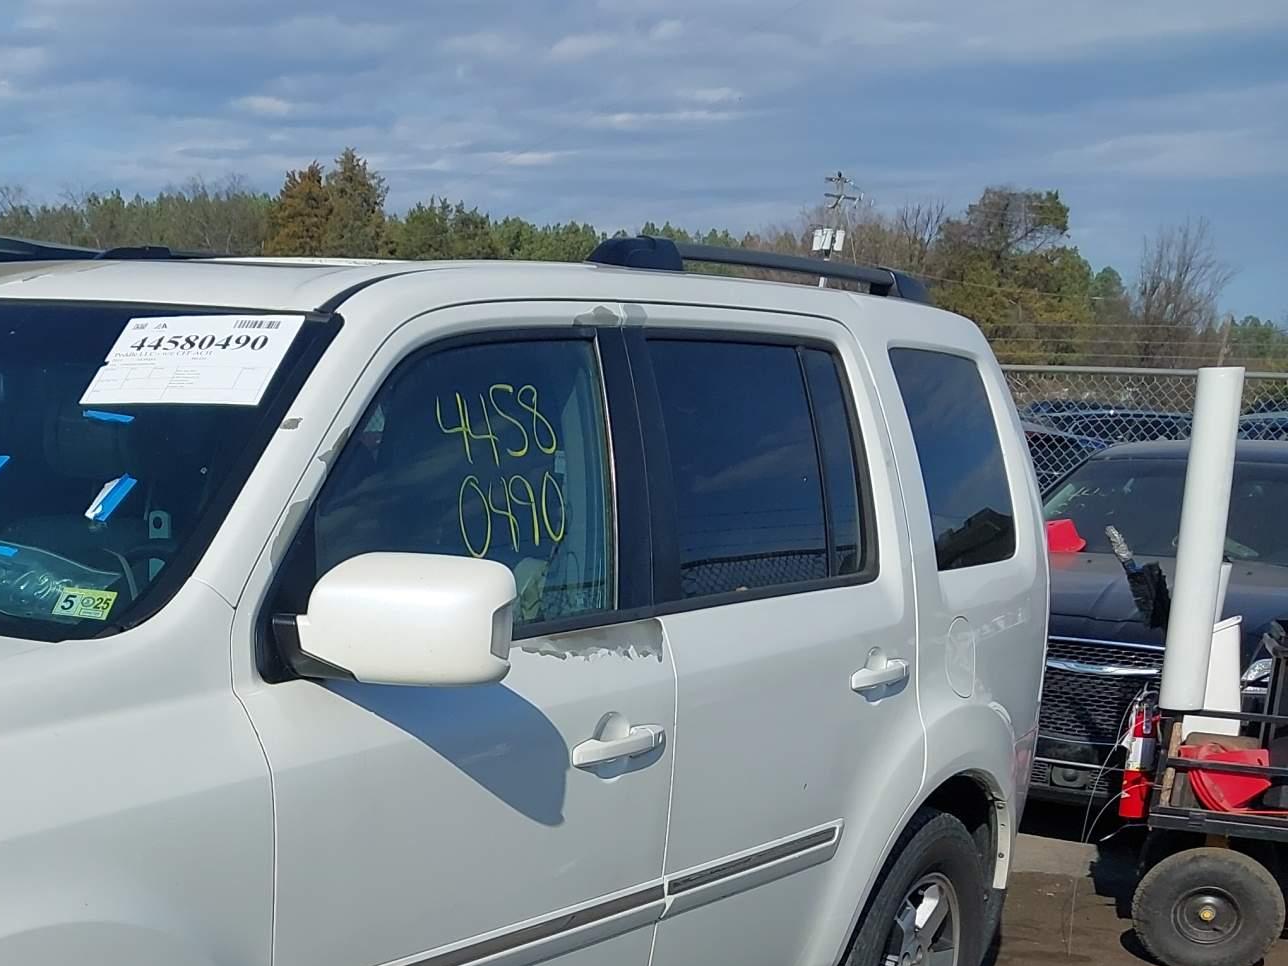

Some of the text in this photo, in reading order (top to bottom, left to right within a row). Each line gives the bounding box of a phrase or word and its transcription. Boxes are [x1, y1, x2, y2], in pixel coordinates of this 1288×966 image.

[130, 334, 269, 351] 44580490
[437, 384, 557, 467] 4458
[459, 471, 565, 558] 0490
[60, 595, 112, 610] 5 25
